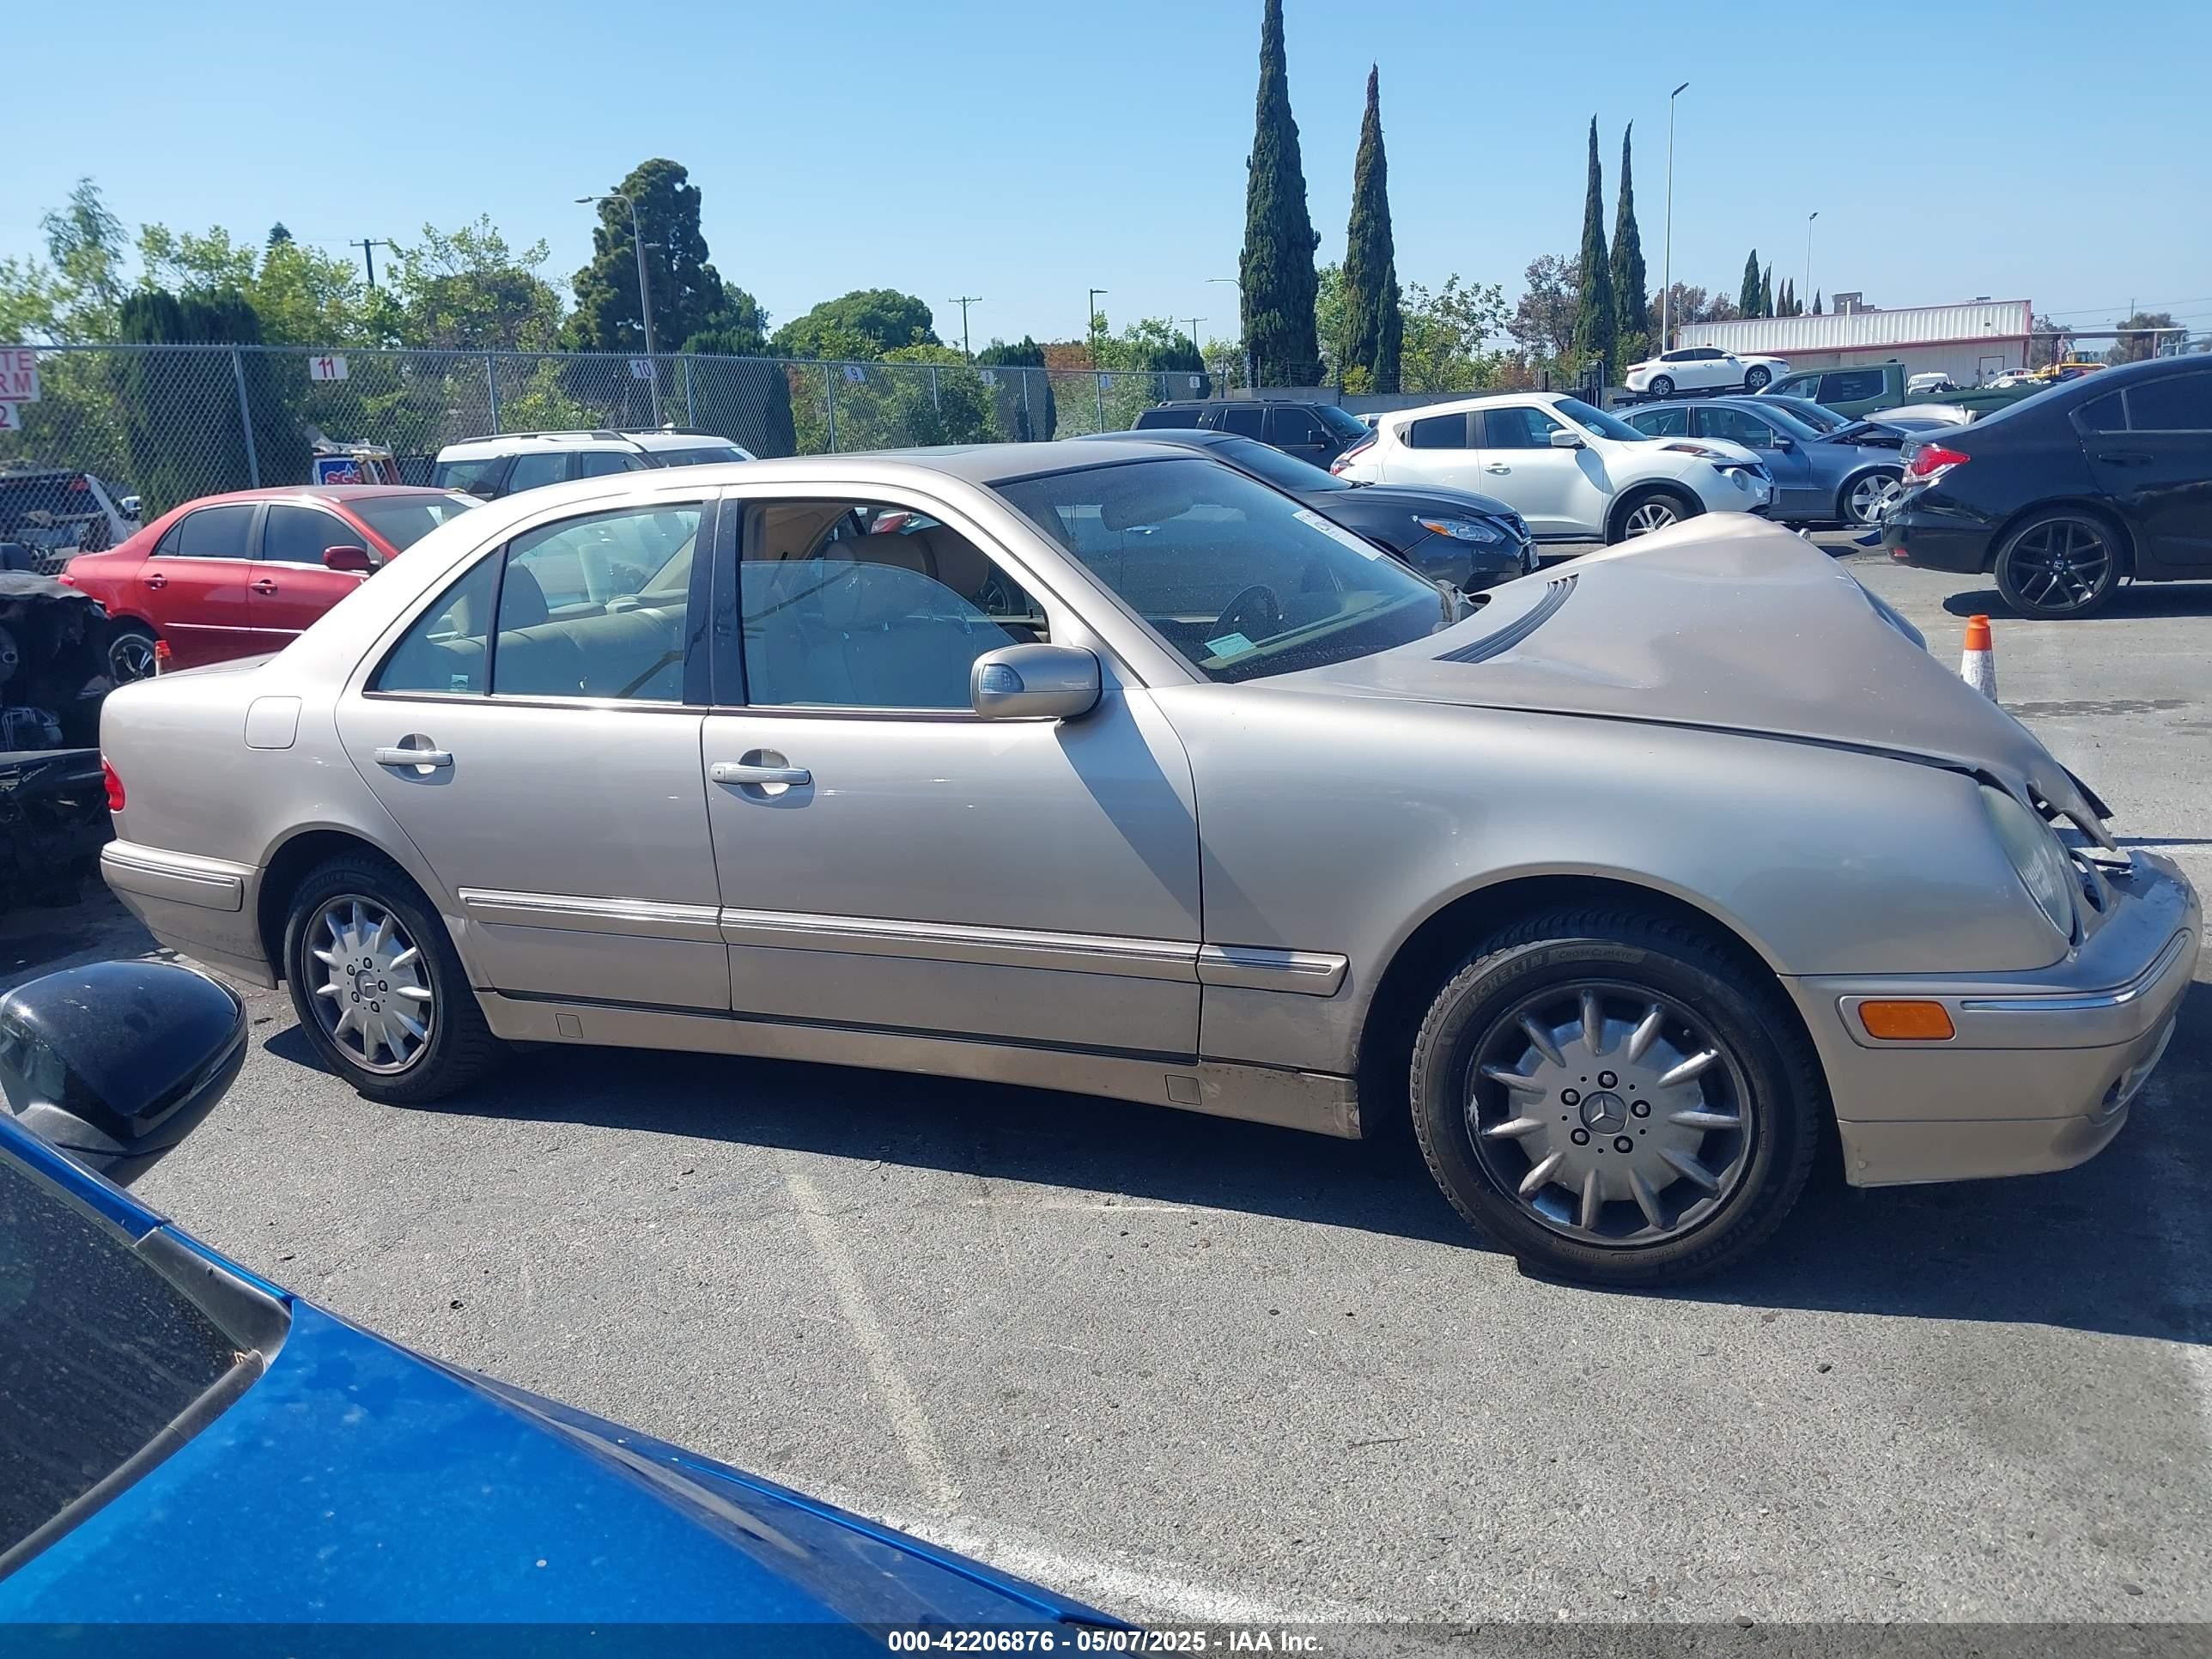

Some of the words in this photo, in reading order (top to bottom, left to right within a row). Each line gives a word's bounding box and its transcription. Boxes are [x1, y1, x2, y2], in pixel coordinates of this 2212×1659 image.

[318, 358, 335, 378] 11
[636, 362, 652, 377] 10
[851, 368, 859, 380] 9
